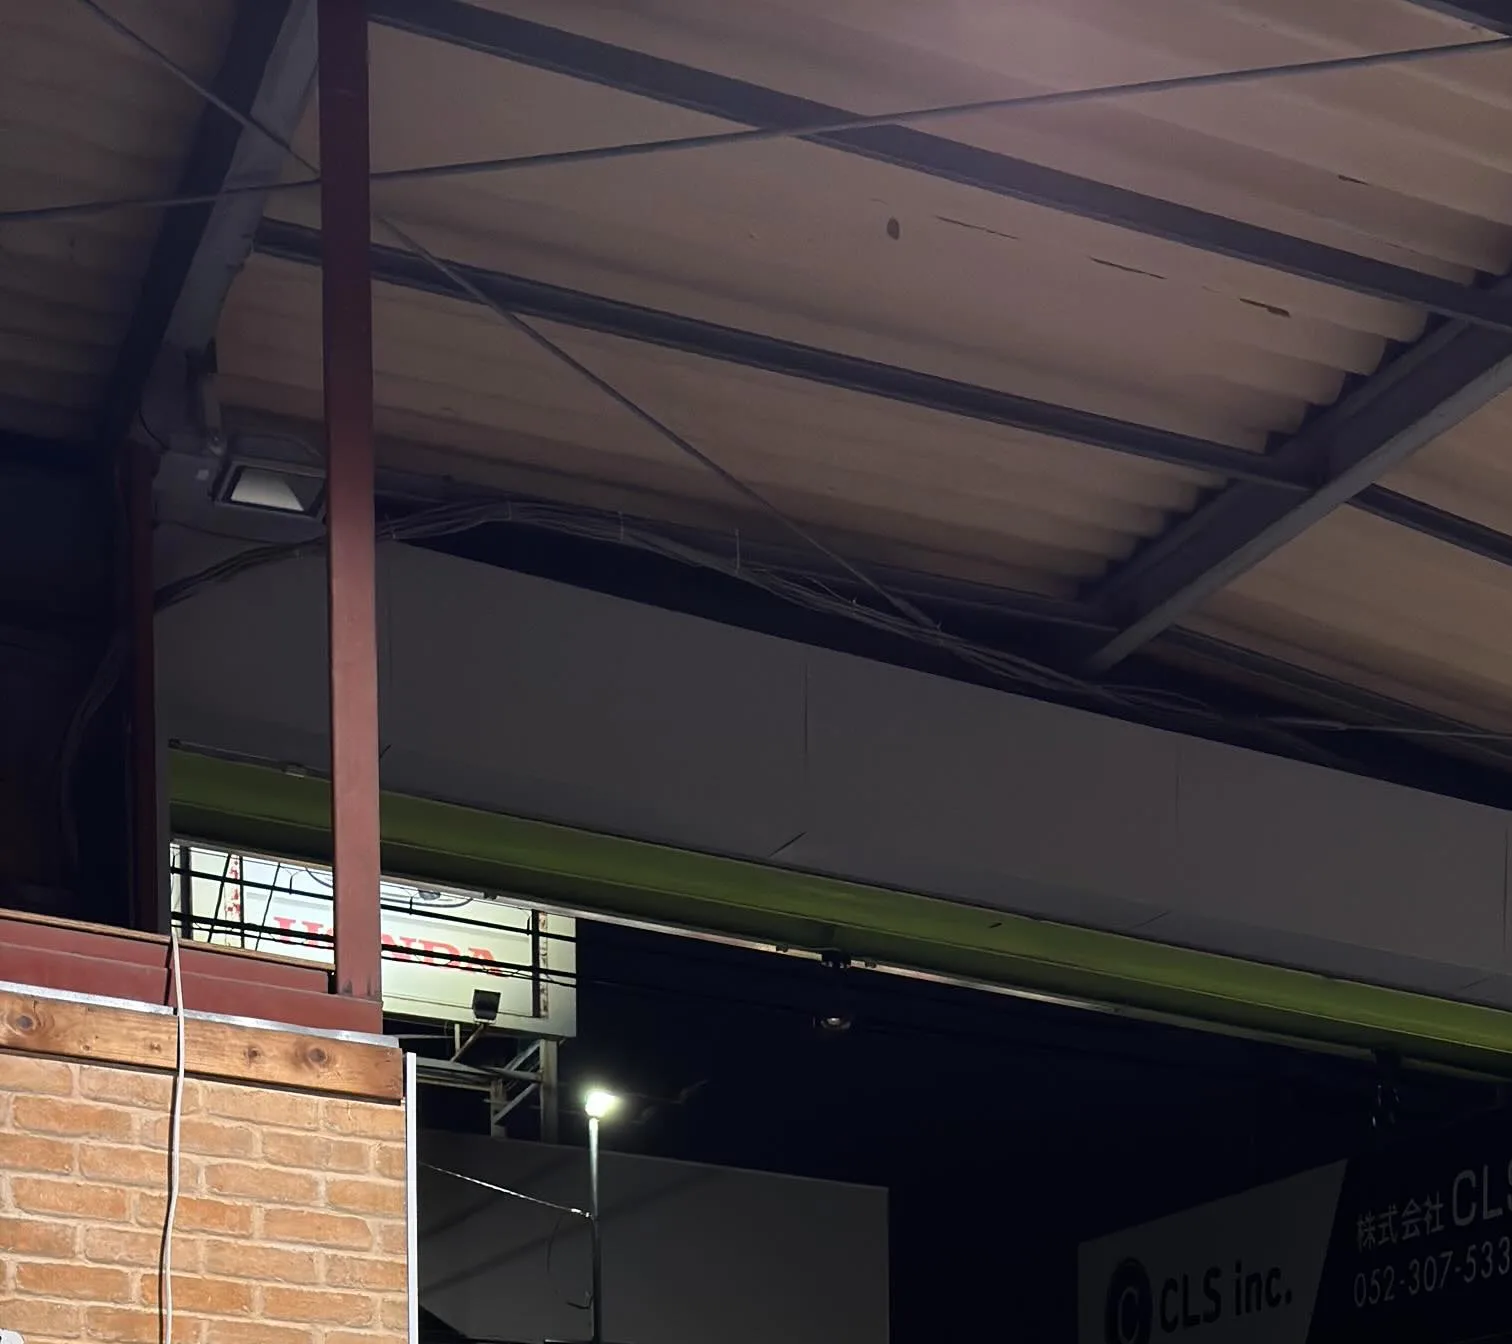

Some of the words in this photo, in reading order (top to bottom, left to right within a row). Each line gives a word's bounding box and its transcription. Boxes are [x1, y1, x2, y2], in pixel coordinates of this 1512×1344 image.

[274, 916, 502, 976] HNDA
[1357, 1191, 1444, 1251] 株式会社
[1160, 1265, 1222, 1333] CLS
[1234, 1259, 1293, 1316] inc.
